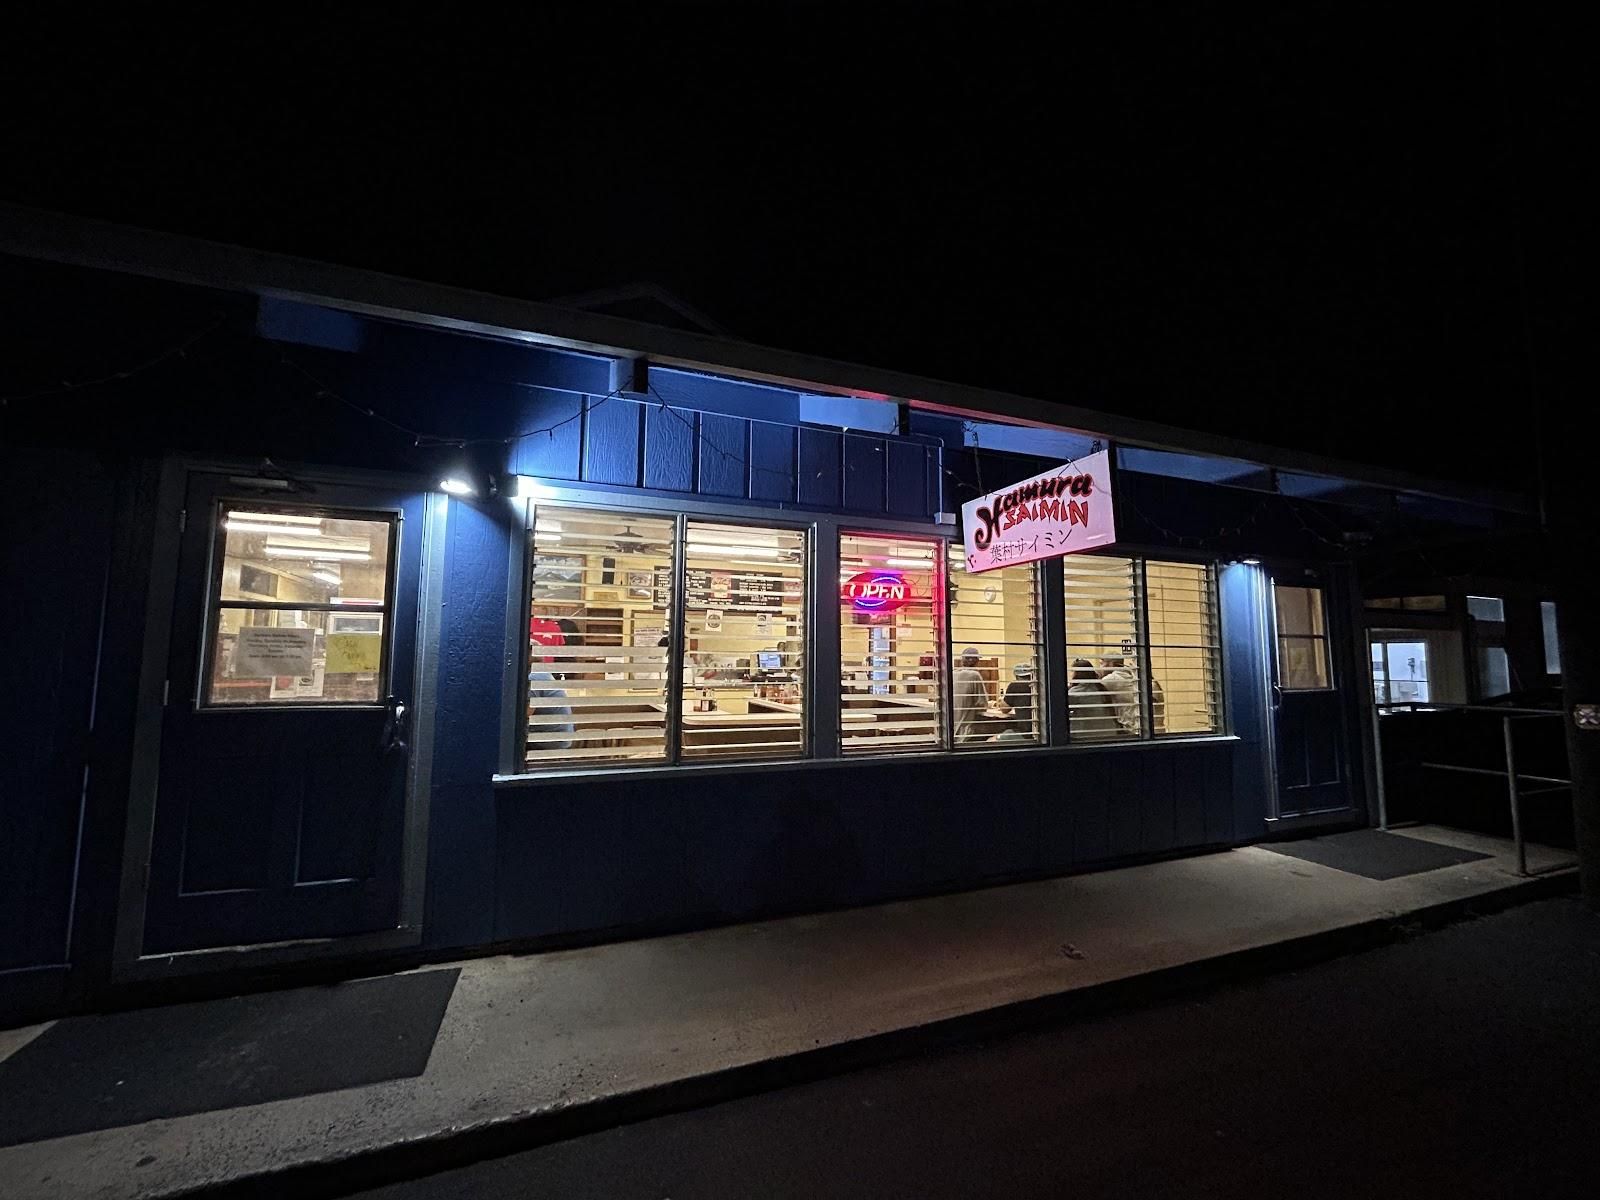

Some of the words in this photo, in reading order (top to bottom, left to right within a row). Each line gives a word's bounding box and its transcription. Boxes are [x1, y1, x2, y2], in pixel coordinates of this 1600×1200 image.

[974, 473, 1093, 551] Hamura
[1003, 498, 1089, 528] SAIMIN
[849, 583, 904, 600] OPEN
